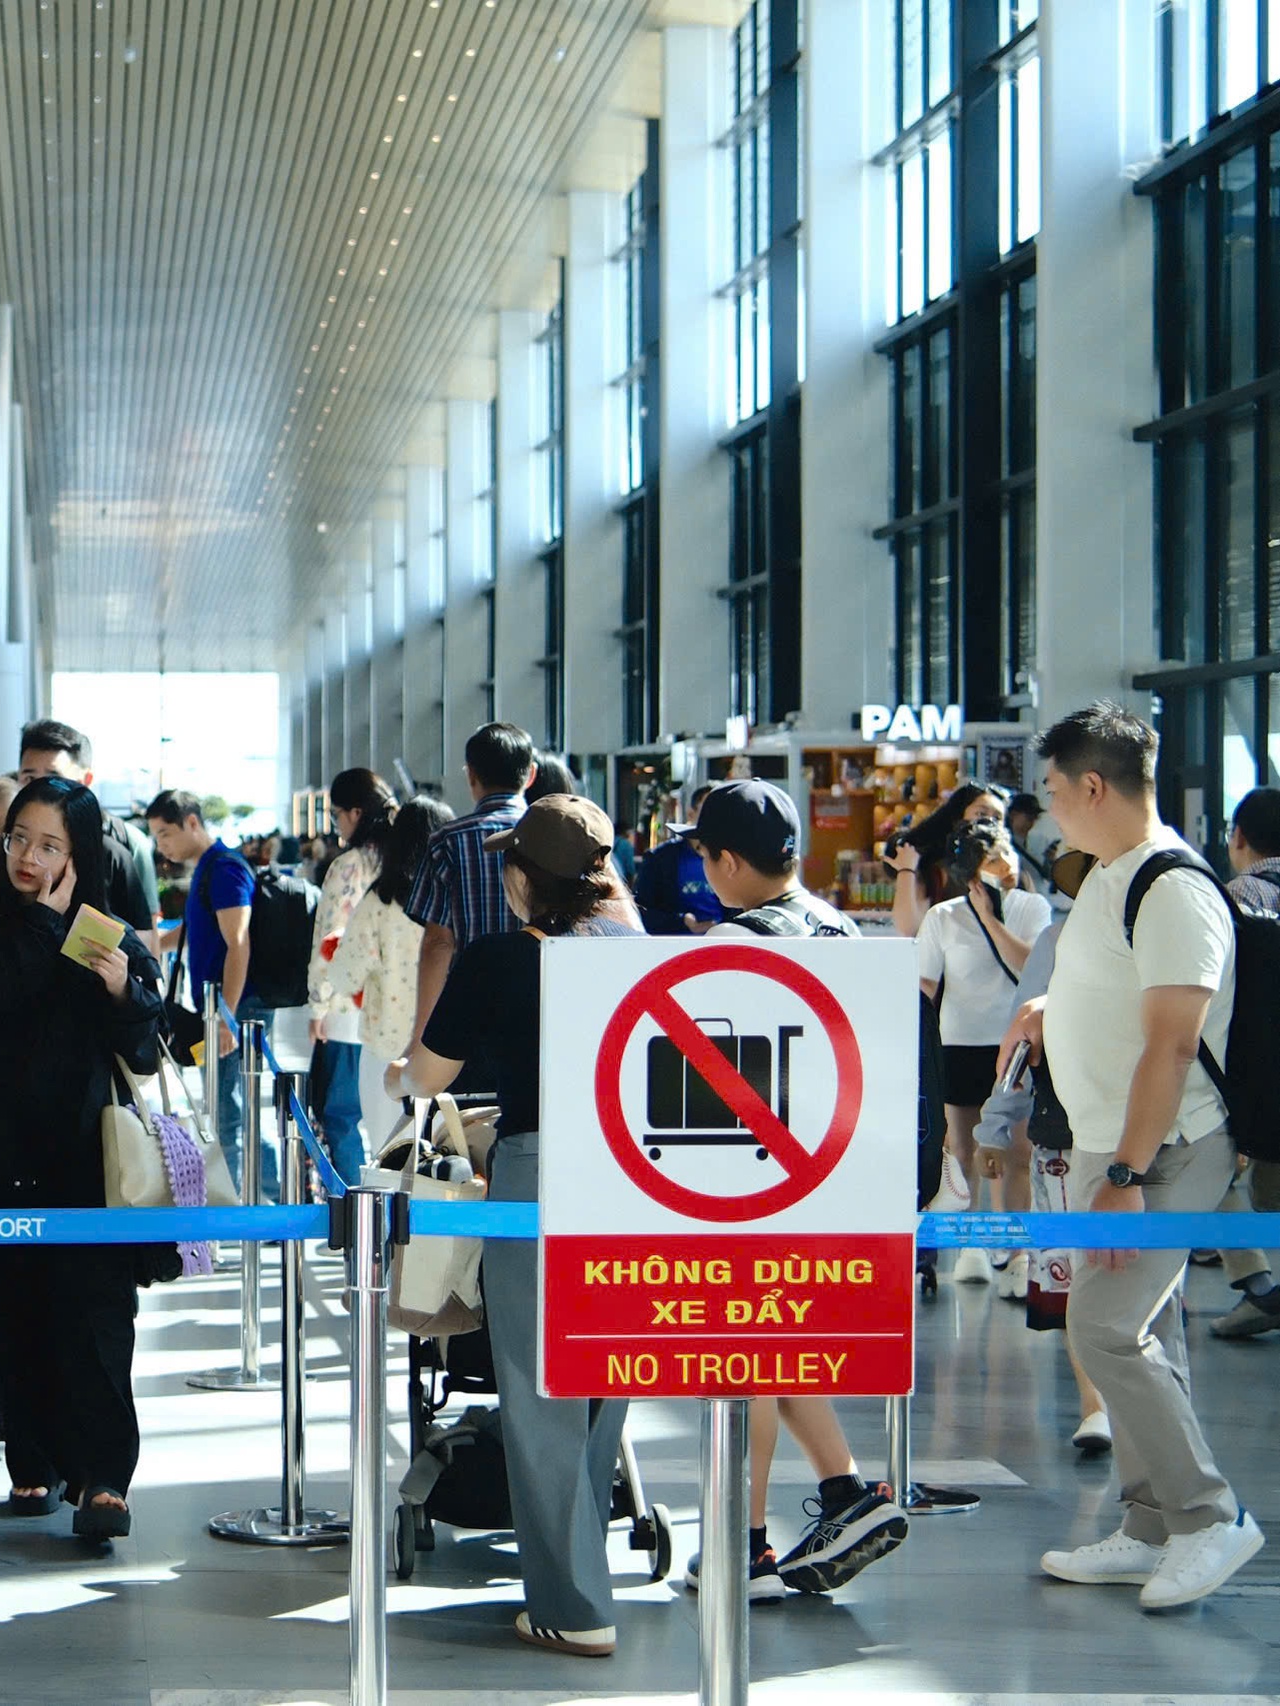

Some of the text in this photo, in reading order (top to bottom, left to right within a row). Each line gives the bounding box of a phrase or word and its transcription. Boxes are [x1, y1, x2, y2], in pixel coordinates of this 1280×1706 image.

[862, 704, 962, 741] PAM
[583, 1253, 873, 1285] KHÔNG DÙNG
[650, 1288, 813, 1325] XE ĐẨY
[606, 1352, 847, 1386] NO TROLLEY
